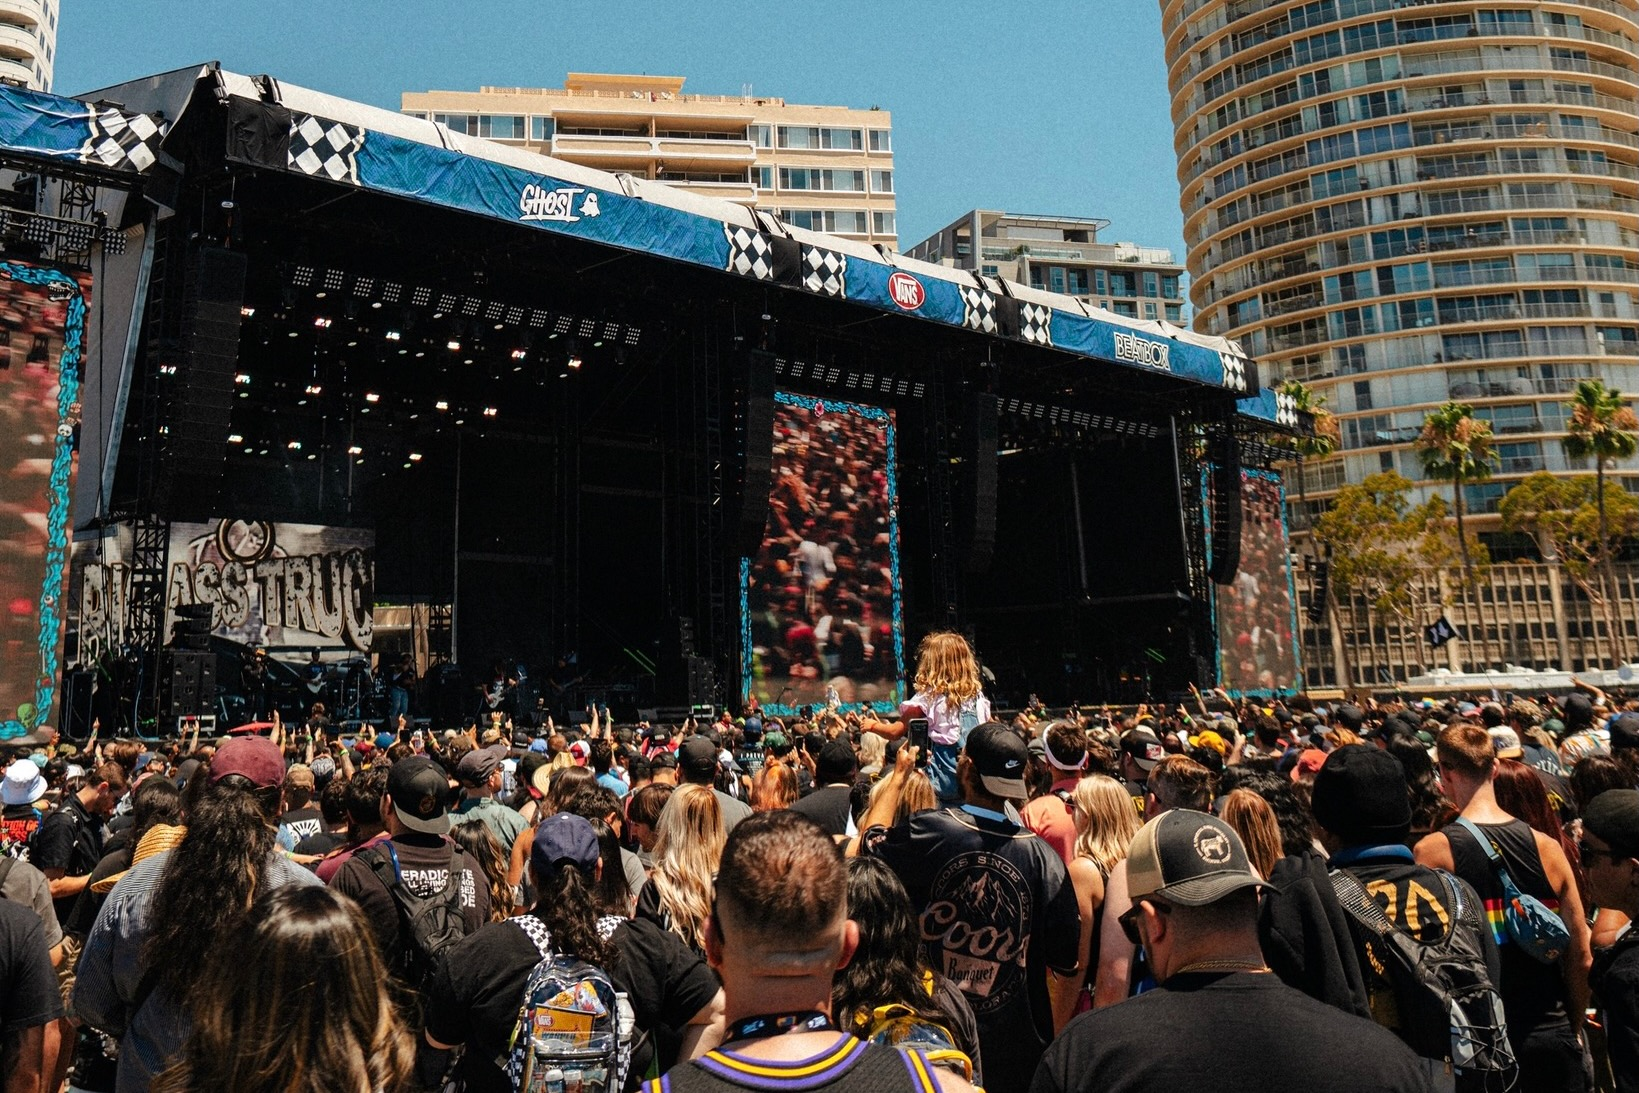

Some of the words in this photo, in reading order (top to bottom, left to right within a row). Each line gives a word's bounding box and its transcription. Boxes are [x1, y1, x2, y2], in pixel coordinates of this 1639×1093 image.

[520, 184, 585, 222] GHOST
[892, 275, 919, 306] VANS
[1113, 331, 1171, 371] BEATBOX
[163, 560, 250, 646] ASS
[255, 548, 375, 652] TRUC
[976, 855, 1020, 883] SNCE
[948, 957, 994, 987] Banquet
